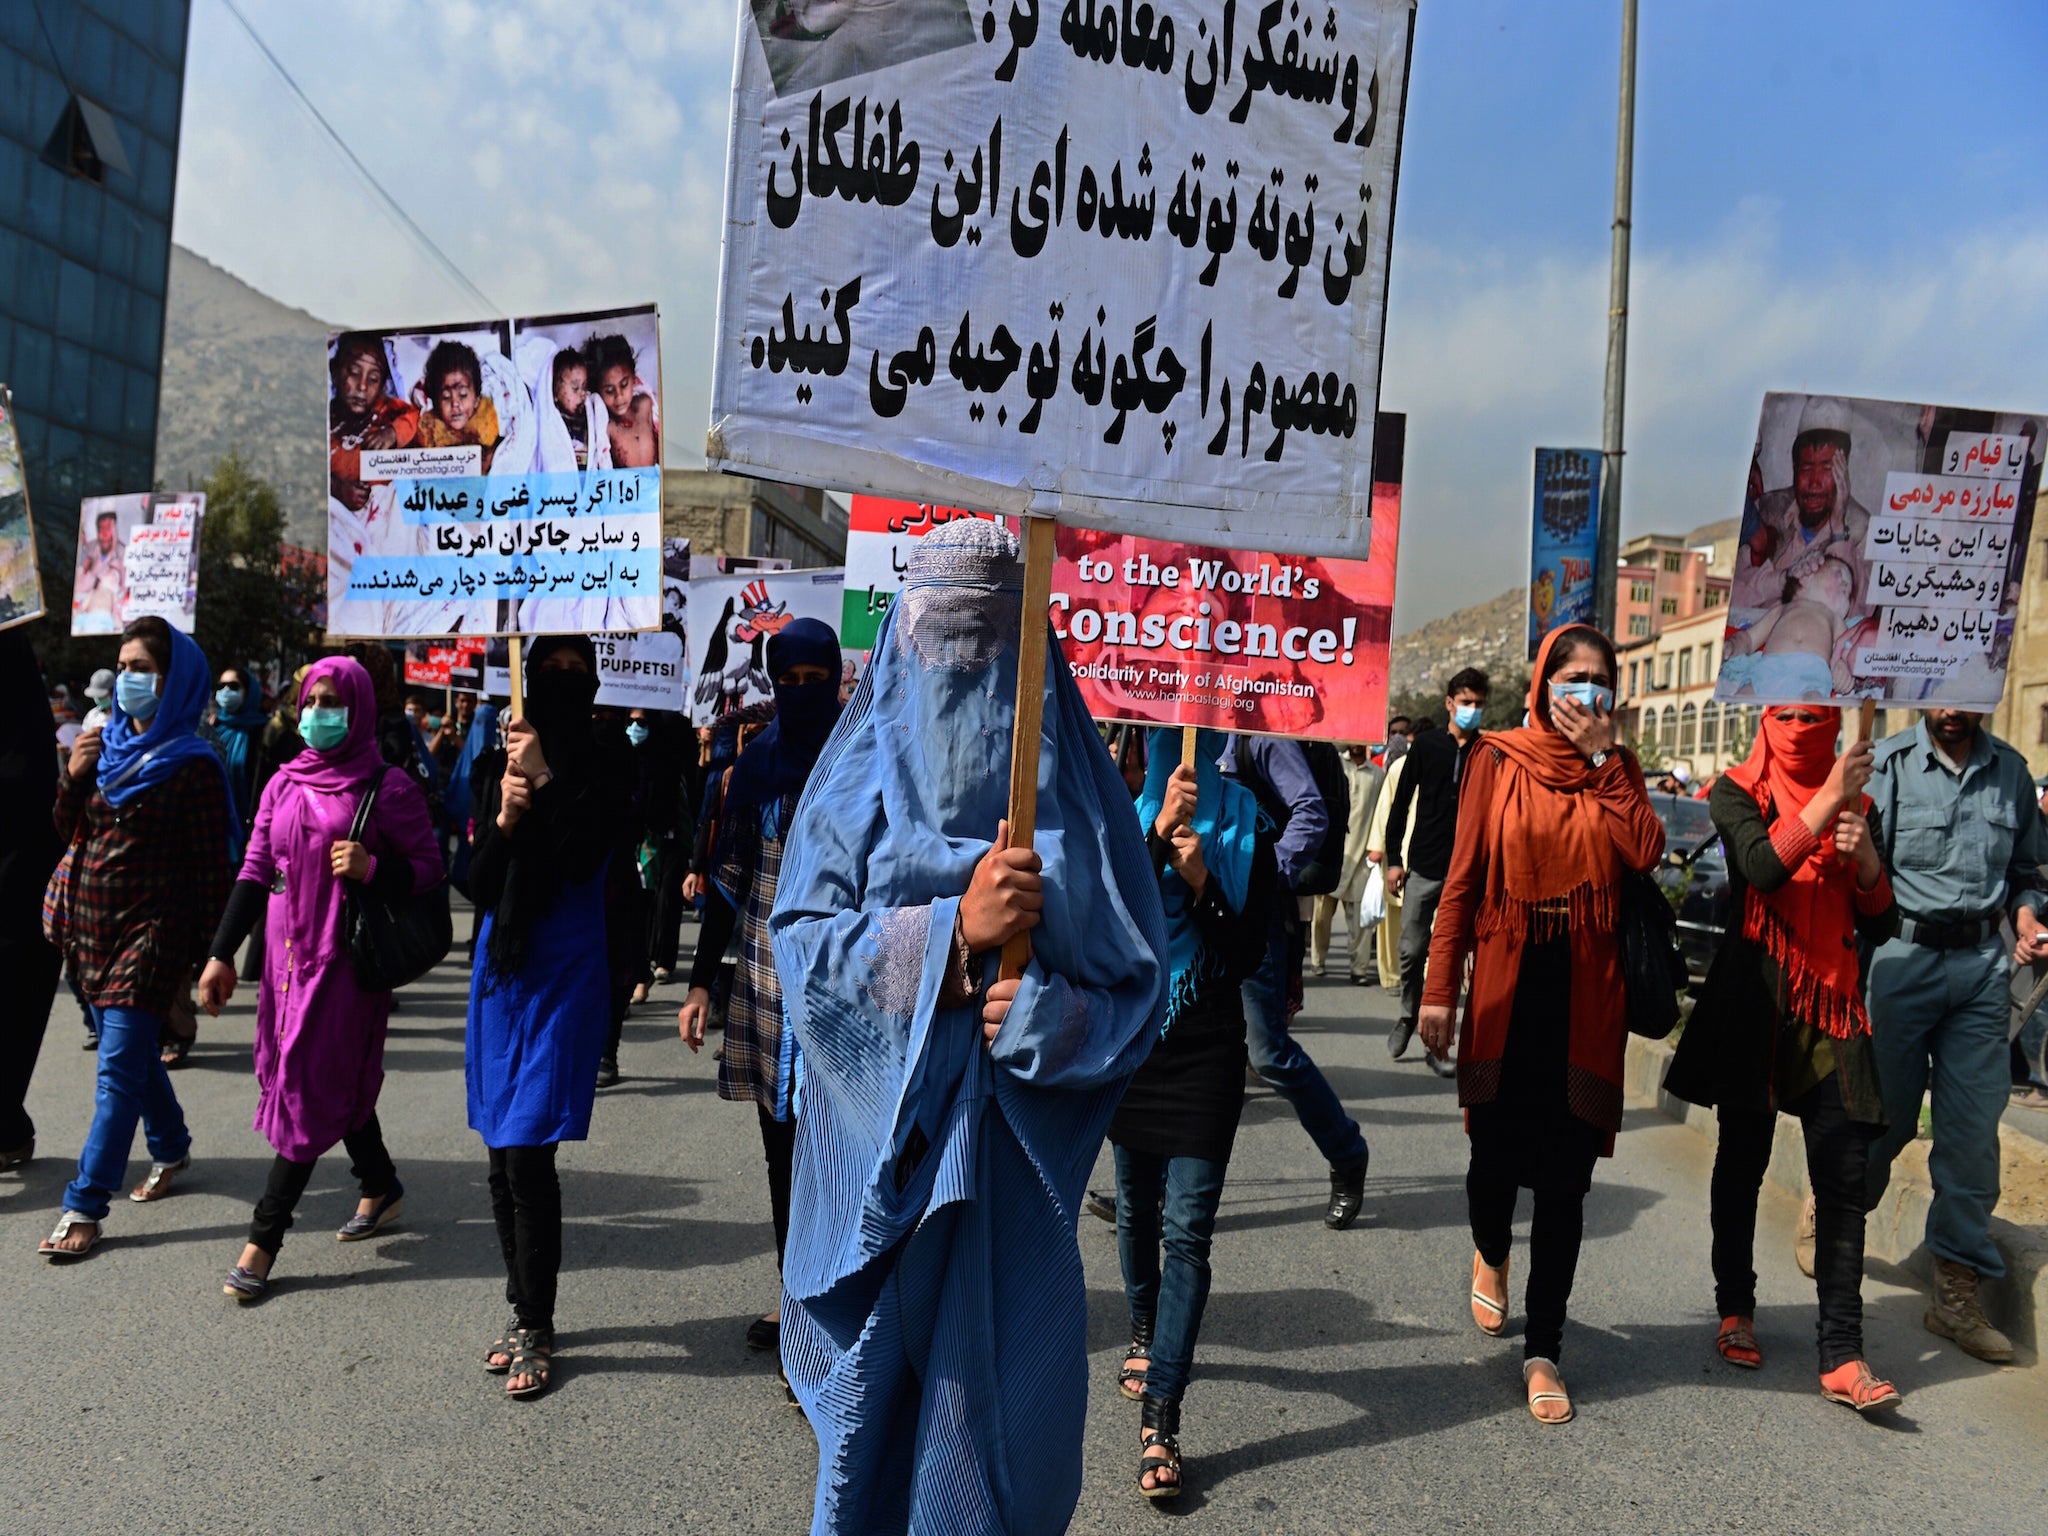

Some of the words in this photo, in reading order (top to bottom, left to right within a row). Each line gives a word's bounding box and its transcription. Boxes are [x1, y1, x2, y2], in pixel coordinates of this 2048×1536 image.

[1185, 0, 1379, 147] روشنفکران
[767, 89, 920, 229] طفلکان
[931, 114, 1002, 248] این
[1010, 123, 1068, 258] ای
[1077, 142, 1156, 241] شده
[1167, 151, 1239, 287] توته
[1248, 167, 1319, 299] توته
[1323, 183, 1373, 306] تن
[751, 275, 862, 405] کنید.
[869, 336, 937, 418] می
[949, 300, 1064, 434] توجیه
[1071, 304, 1188, 456] چگونه
[1200, 318, 1232, 456] را
[1242, 361, 1357, 463] معصوم
[368, 453, 411, 468] افغانستان
[377, 464, 465, 477] www.hambastagi.org
[456, 450, 477, 463] حزب
[1948, 450, 1959, 472] و
[1964, 436, 2003, 472] قیام
[2007, 443, 2023, 474] با
[475, 497, 484, 518] و
[491, 484, 530, 514] غنی
[537, 491, 579, 518] پسر
[585, 480, 613, 513] اگر
[1889, 483, 1956, 514] مردمی
[1961, 480, 2015, 517] مبارزه
[436, 524, 493, 559] امریکا
[499, 521, 571, 556] چاکران
[578, 522, 624, 553] سایر
[631, 532, 640, 552] و
[1873, 521, 1942, 553] جنایات
[1948, 526, 1984, 558] این
[1987, 530, 2007, 559] به
[452, 566, 486, 597] دچار
[492, 566, 575, 594] سرنوشت
[581, 561, 613, 591] این
[619, 567, 640, 590] به
[1078, 554, 1113, 583] to
[1122, 554, 1180, 589] the
[1990, 582, 2000, 601] و
[1888, 607, 1939, 640] دهیم!
[1944, 609, 1993, 646] پایان
[1068, 661, 1144, 686] Solidarity
[1148, 669, 1190, 689] Party
[1194, 671, 1211, 689] of
[1214, 673, 1315, 698] Afghanistan
[1871, 665, 1946, 676] www.hambastagi.org
[1124, 687, 1256, 712] www.hambastagi.org
